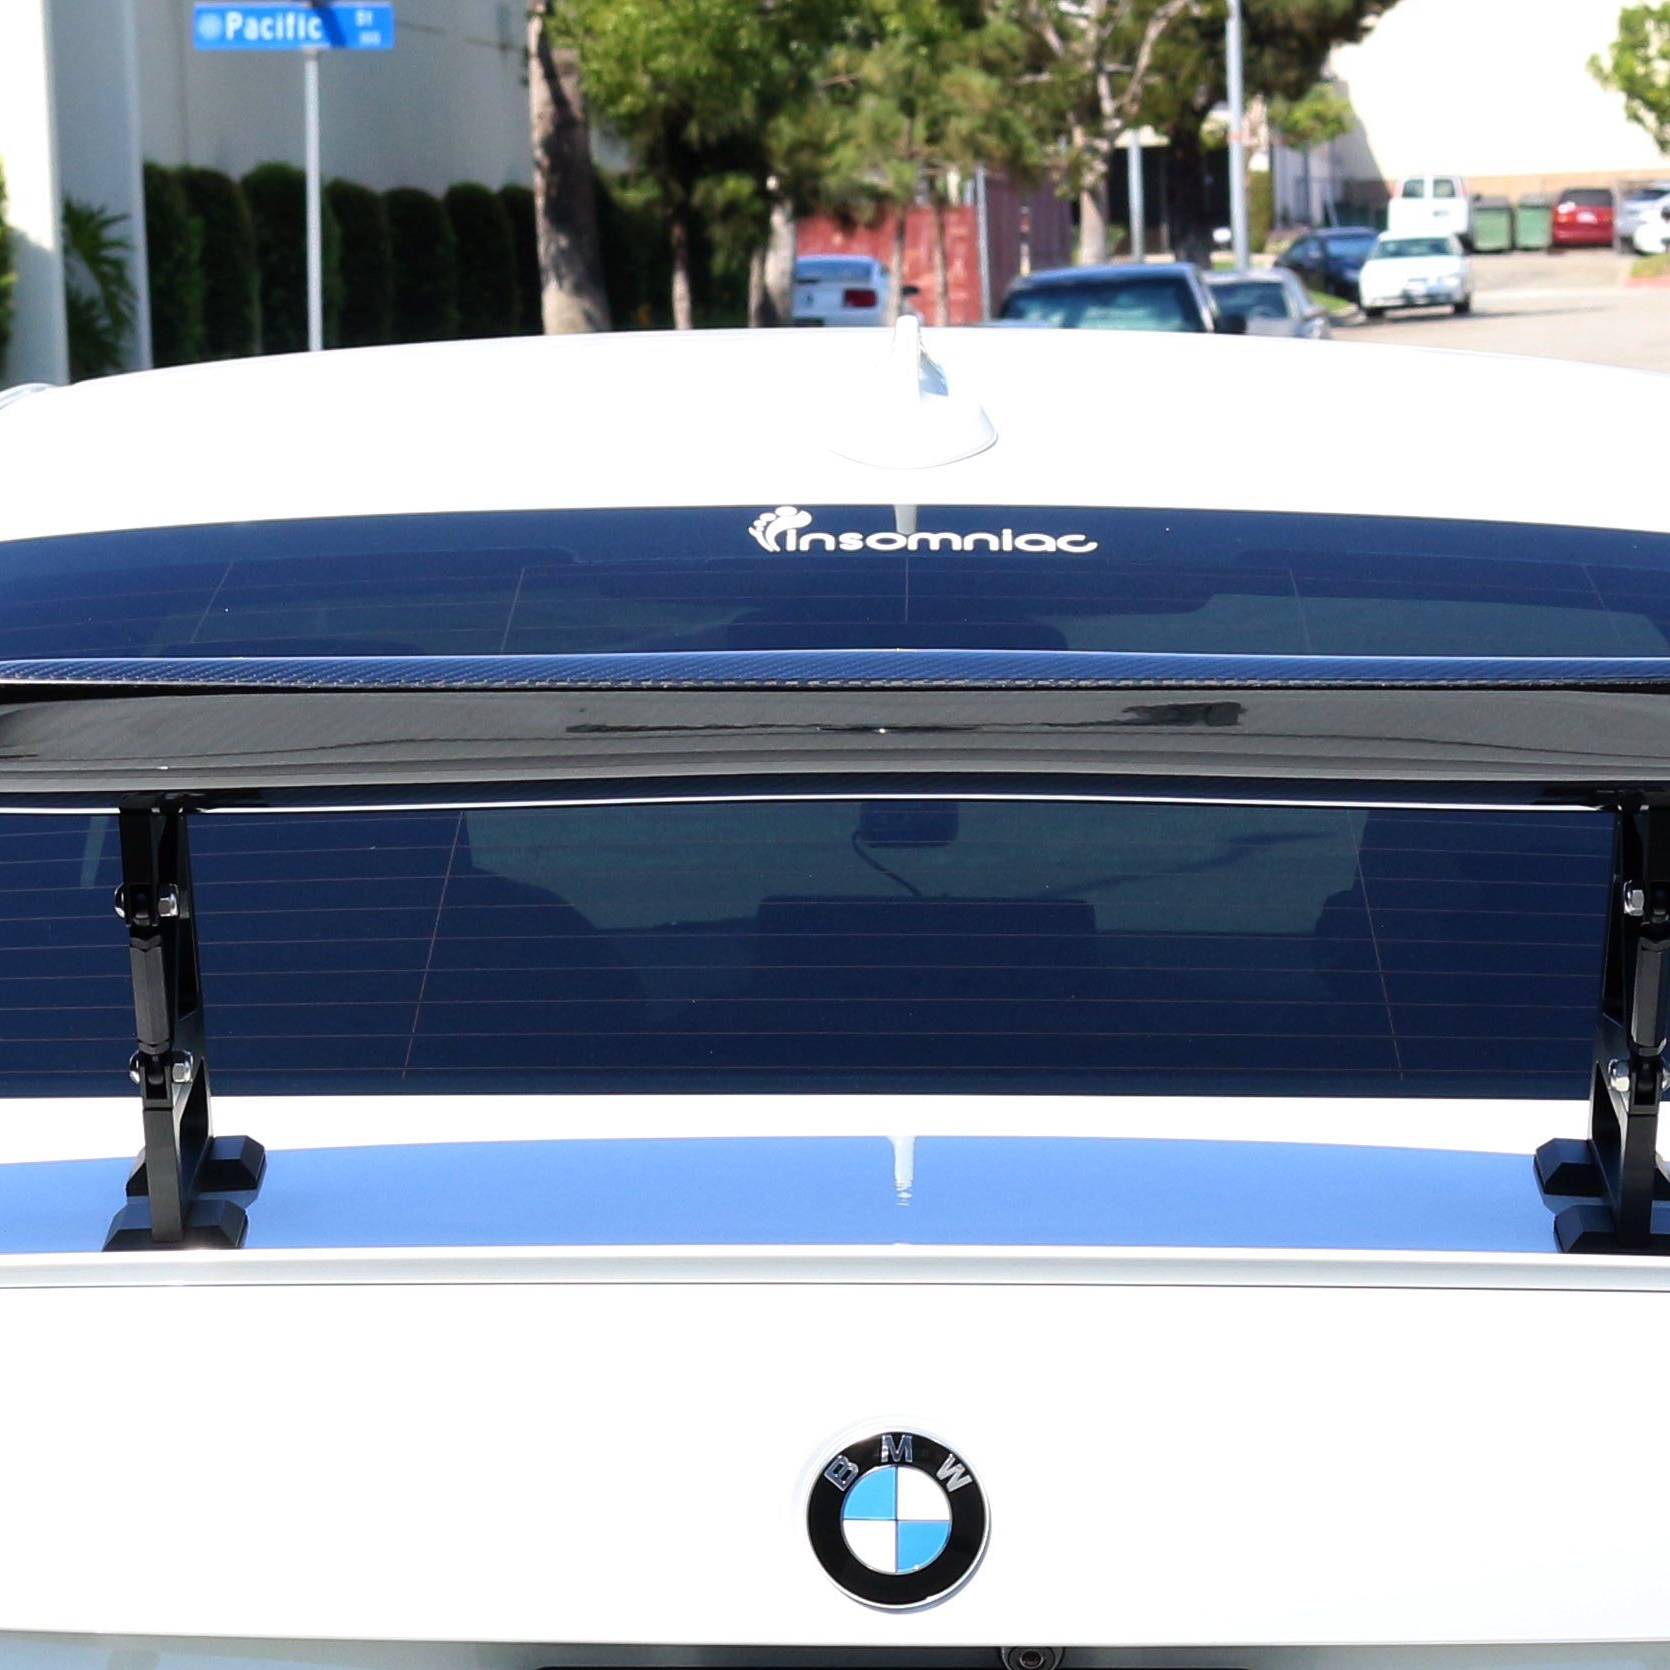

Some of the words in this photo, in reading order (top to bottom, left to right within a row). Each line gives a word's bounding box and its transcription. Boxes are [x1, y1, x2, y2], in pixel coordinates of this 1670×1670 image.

[224, 10, 323, 41] Pacific
[784, 527, 1099, 553] insomniac
[823, 1434, 973, 1493] BMW
